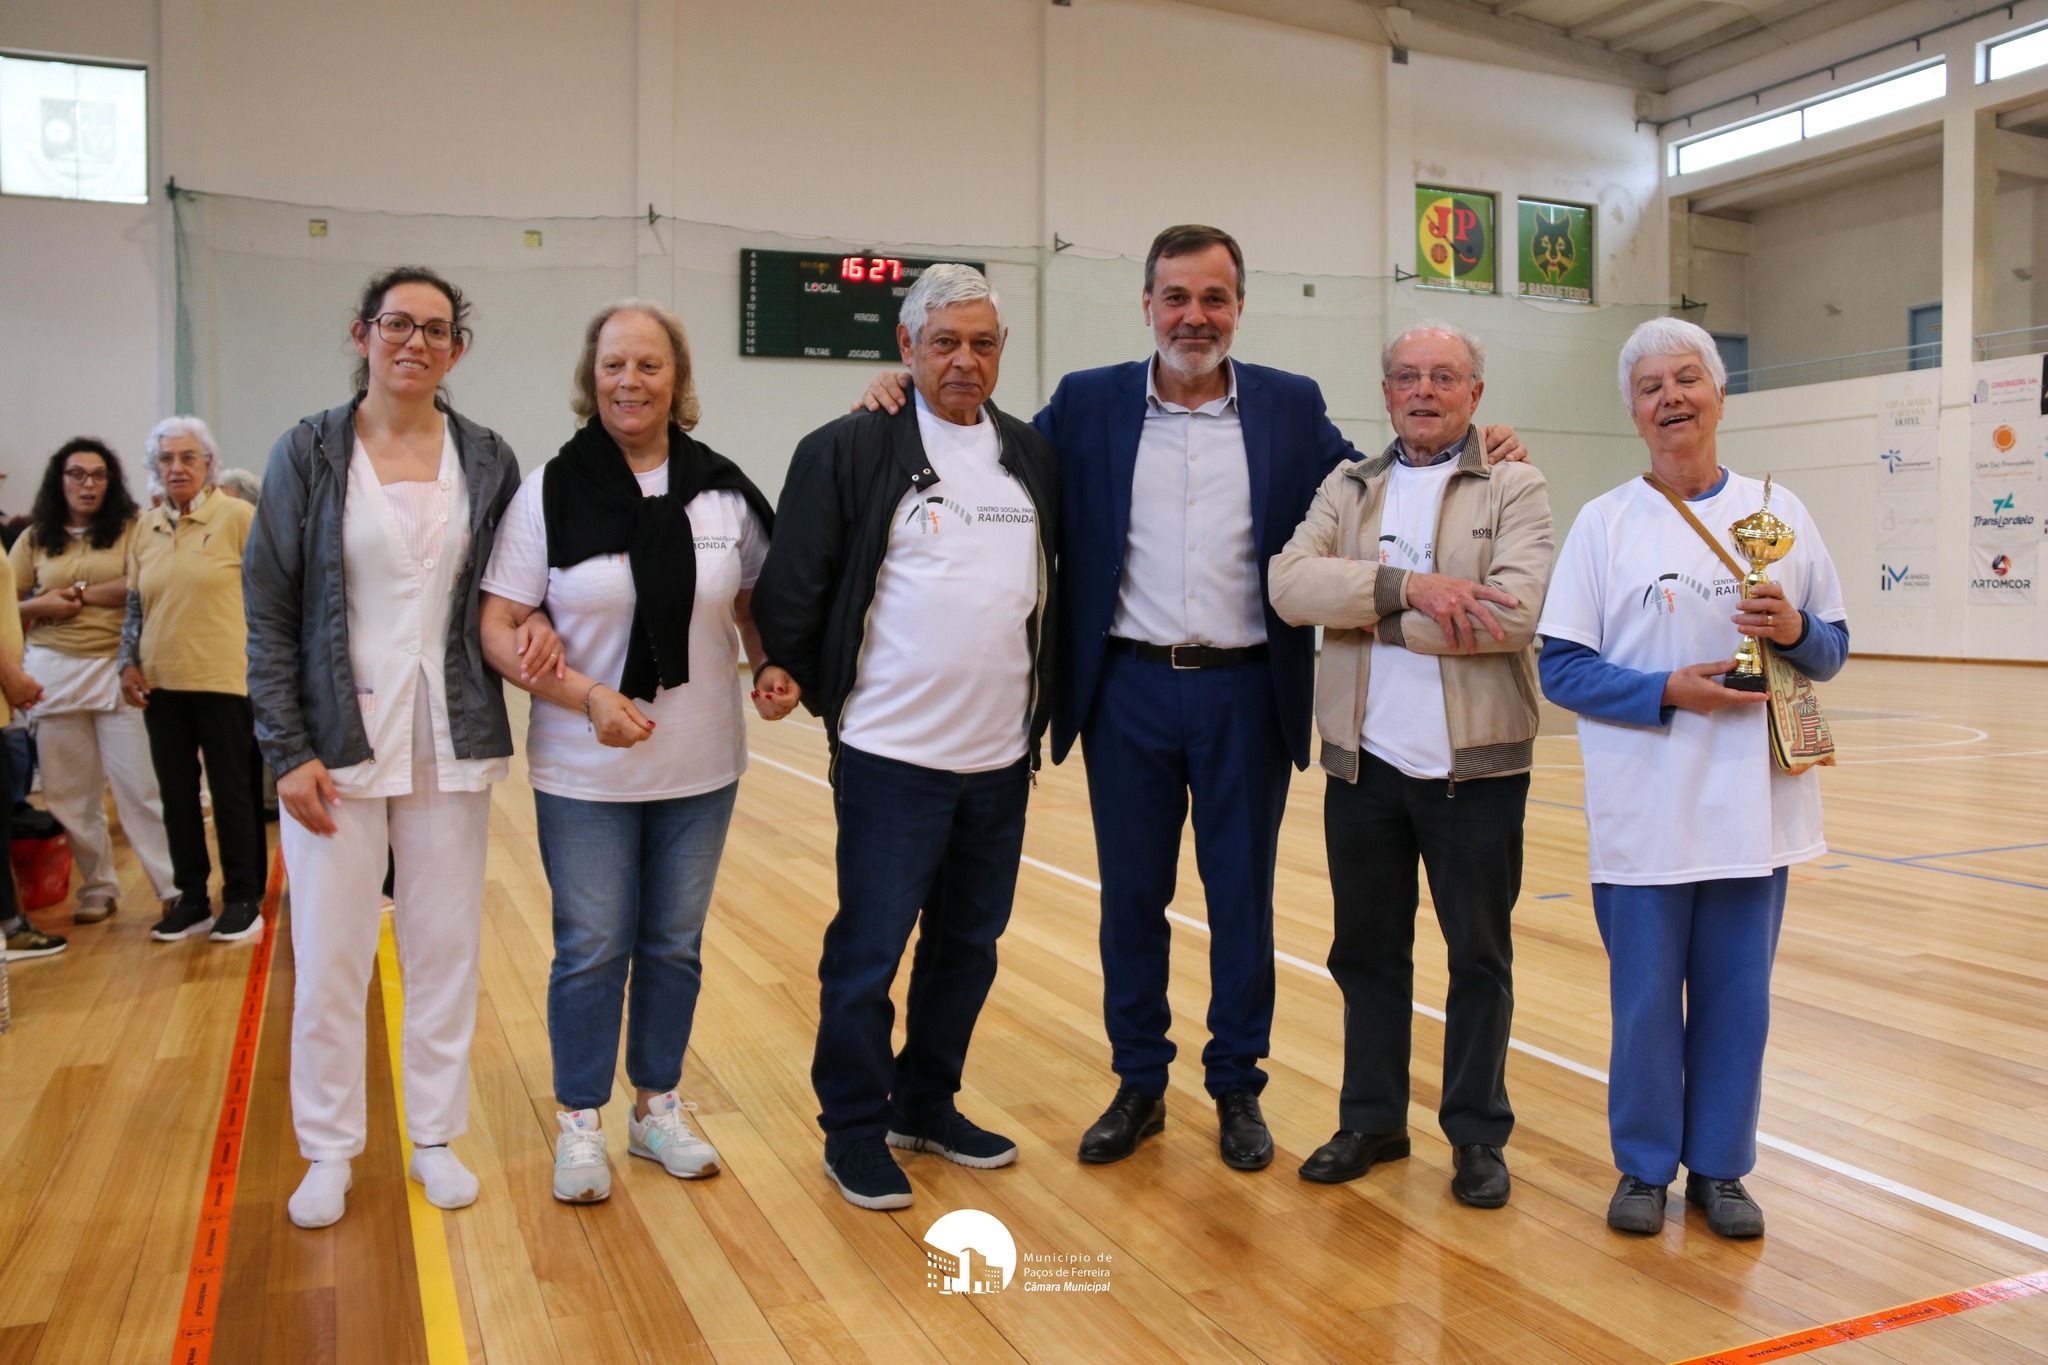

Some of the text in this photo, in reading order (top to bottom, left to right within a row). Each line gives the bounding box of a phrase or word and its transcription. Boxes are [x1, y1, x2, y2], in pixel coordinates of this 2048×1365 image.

[804, 282, 841, 293] LOCAL
[892, 287, 910, 297] VISIT
[804, 347, 831, 357] FALTAS
[847, 350, 880, 359] JOGADOR
[1895, 416, 1921, 427] HOTEL
[976, 505, 1000, 513] CENTRO
[1000, 506, 1021, 514] SOCIAL
[978, 513, 1034, 523] RAIMONDA
[1472, 527, 1493, 537] BOSS
[1713, 578, 1739, 586] CENTRO
[1971, 579, 2031, 589] ARTOMCOR
